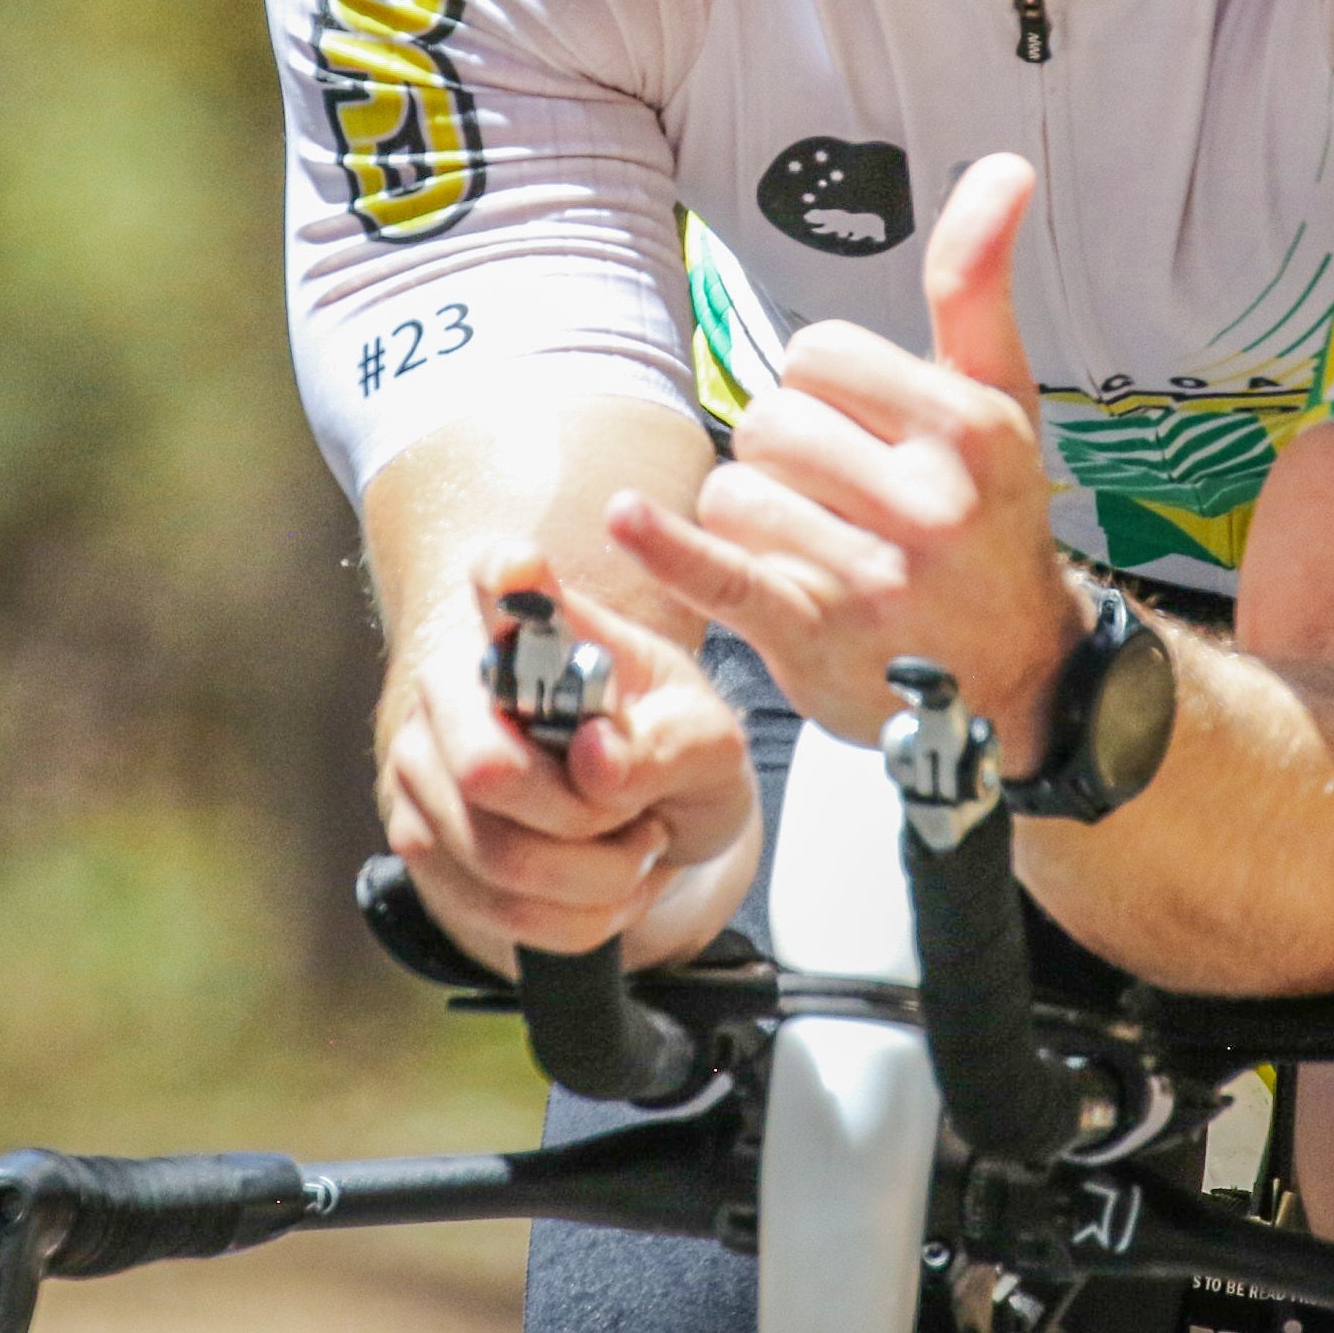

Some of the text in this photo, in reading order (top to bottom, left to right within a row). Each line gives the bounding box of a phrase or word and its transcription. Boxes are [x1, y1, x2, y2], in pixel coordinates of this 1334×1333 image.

[357, 302, 475, 398] #23
[1205, 1275, 1222, 1293] TO
[1226, 1278, 1245, 1298] BE
